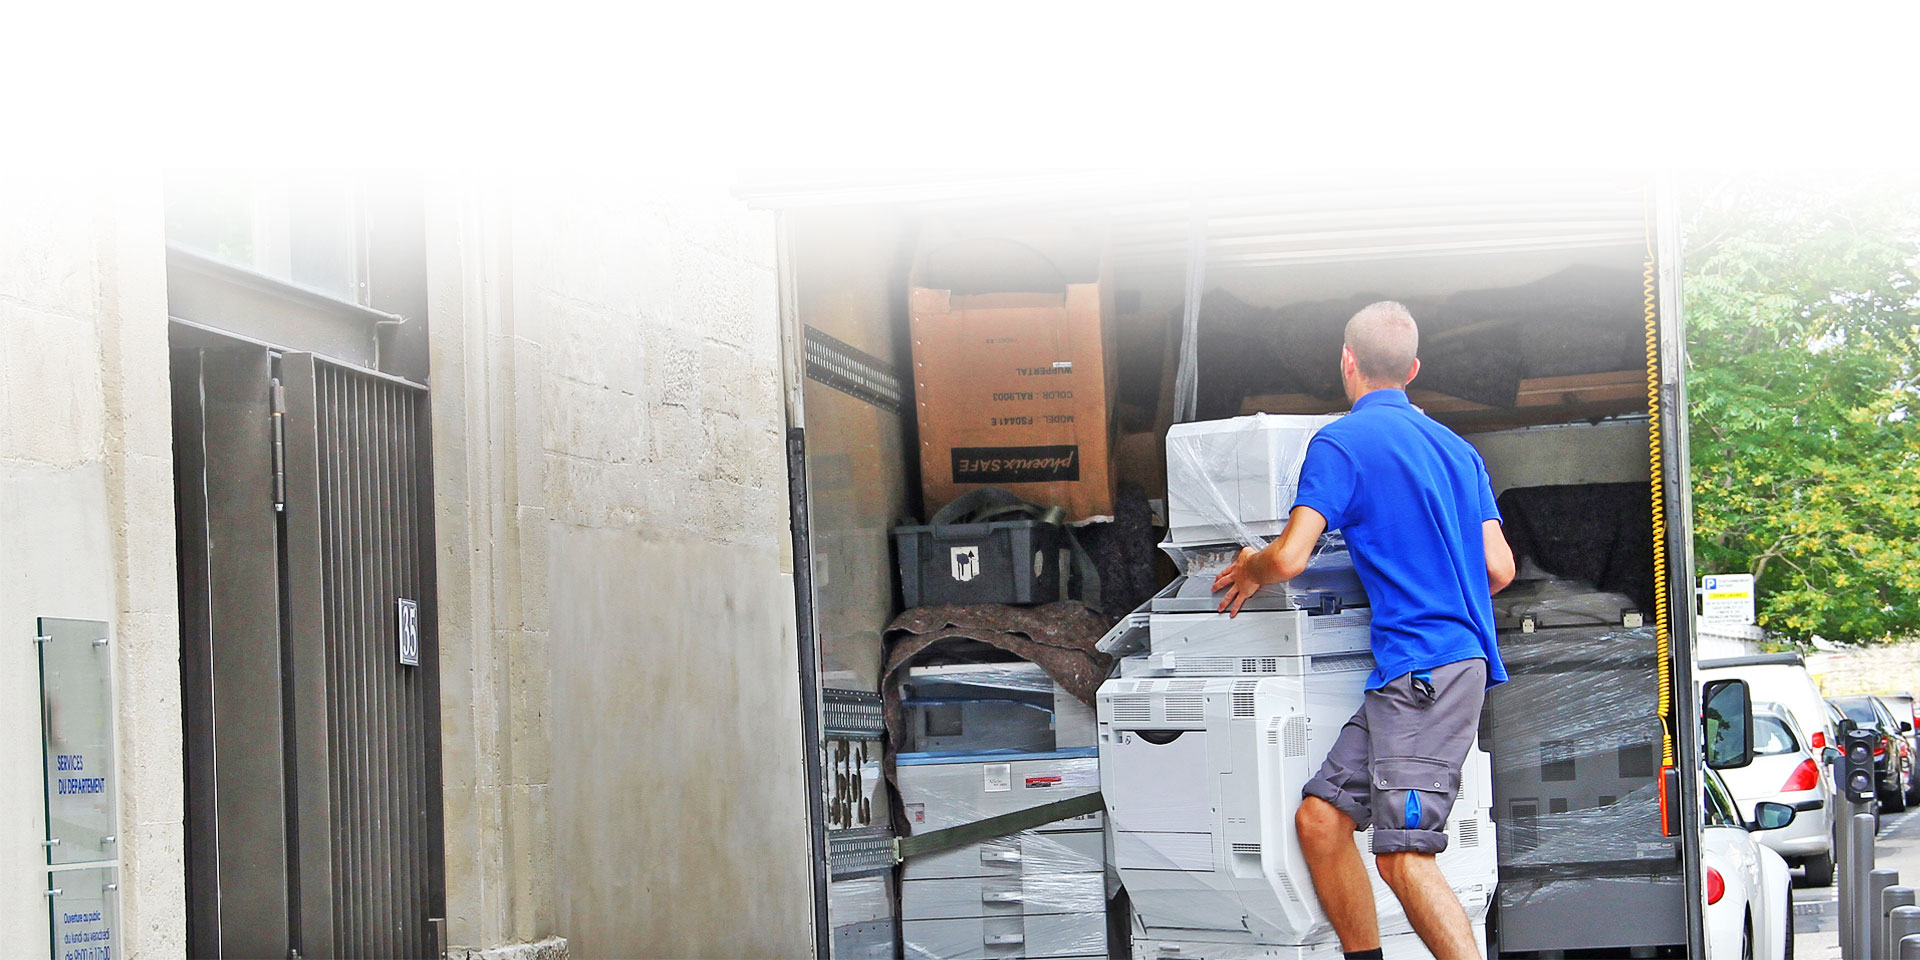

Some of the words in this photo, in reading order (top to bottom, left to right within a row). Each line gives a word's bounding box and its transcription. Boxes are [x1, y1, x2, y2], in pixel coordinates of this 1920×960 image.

[1016, 366, 1072, 376] WUPPERTAL
[993, 392, 1033, 402] RAL9003
[1043, 391, 1073, 400] COLOR
[1044, 415, 1074, 424] MODEL
[959, 459, 1000, 473] SAFE
[1004, 450, 1074, 474] phoenix
[403, 605, 416, 656] 35
[57, 755, 83, 771] SERVICES
[58, 778, 67, 795] DU
[68, 777, 105, 794] DEPARTEMENT
[64, 912, 82, 924] Ouverture
